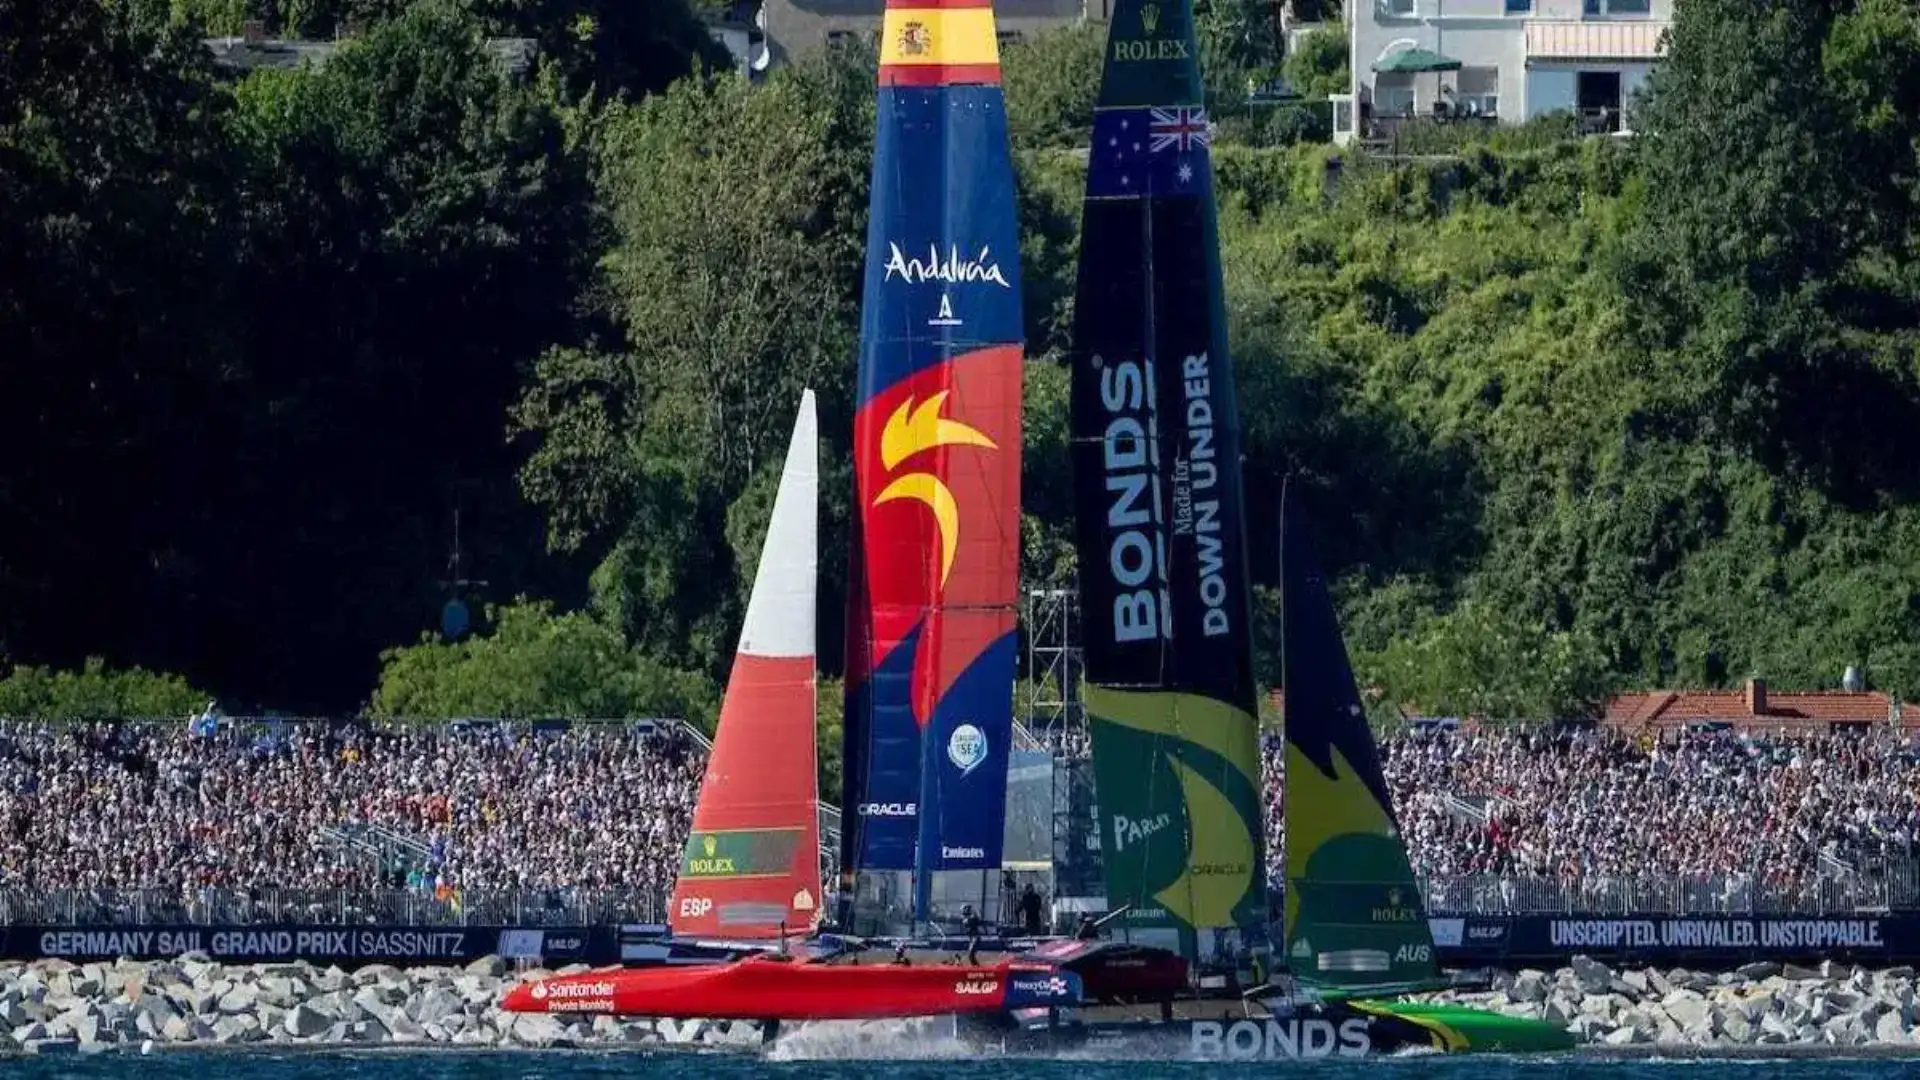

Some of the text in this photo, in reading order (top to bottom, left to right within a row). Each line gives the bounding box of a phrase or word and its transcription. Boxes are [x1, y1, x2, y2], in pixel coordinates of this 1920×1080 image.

[1114, 40, 1190, 61] ROLEX
[884, 241, 1011, 288] Andalucía
[1101, 361, 1157, 642] BONDS
[1183, 352, 1230, 637] DOWN UNDER
[1172, 482, 1193, 536] Made
[858, 803, 917, 815] ORACLE
[942, 846, 985, 859] Emirates
[689, 858, 735, 873] ROLEX
[680, 898, 712, 918] ESP
[40, 931, 464, 956] GERMANY SAIL GRAND PRIX SASSNITZ
[1551, 920, 1883, 946] UNSCRIPTED. UNRIVALED. UNSTOPPABLE.
[1395, 944, 1430, 962] AUS
[548, 981, 615, 997] Santander
[955, 981, 998, 994] SAILGP
[1191, 1018, 1370, 1058] BONDS
